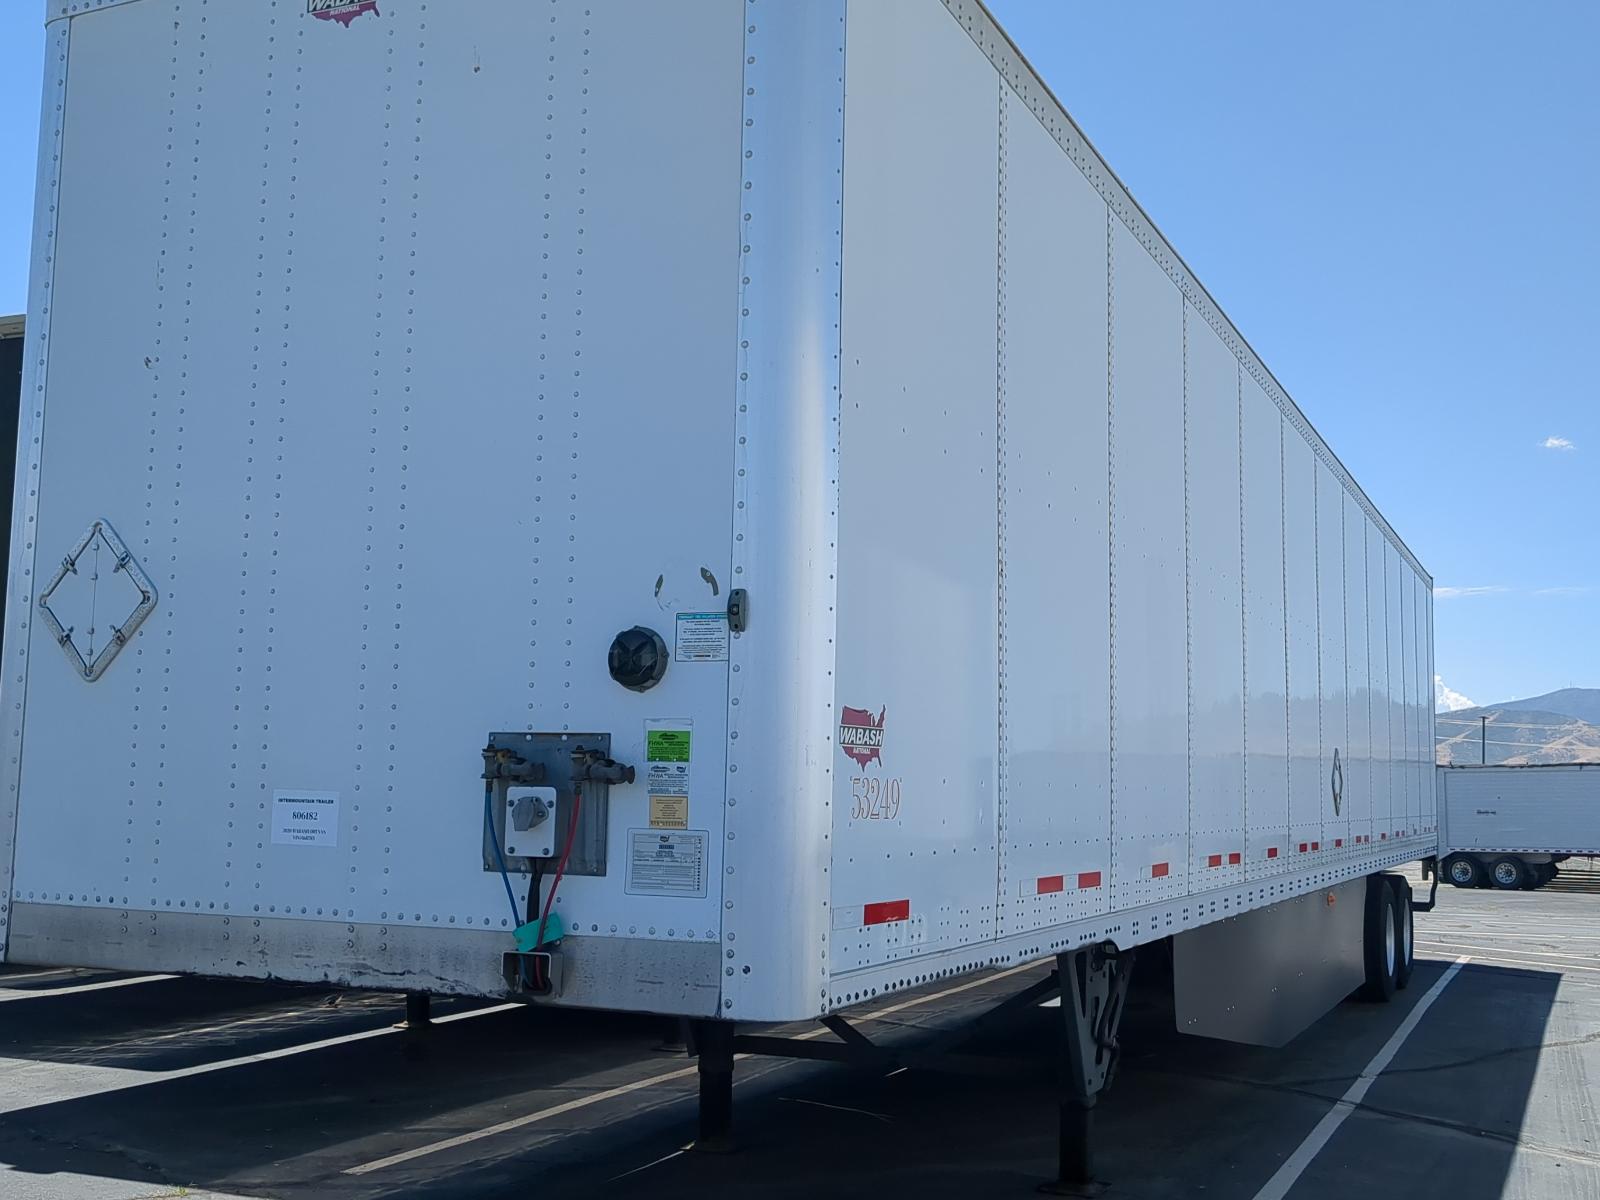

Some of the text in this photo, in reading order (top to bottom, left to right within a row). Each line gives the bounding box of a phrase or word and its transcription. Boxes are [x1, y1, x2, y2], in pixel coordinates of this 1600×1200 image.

[329, 5, 360, 16] NATIONAL
[840, 728, 882, 746] WABASH
[851, 777, 900, 820] 53249
